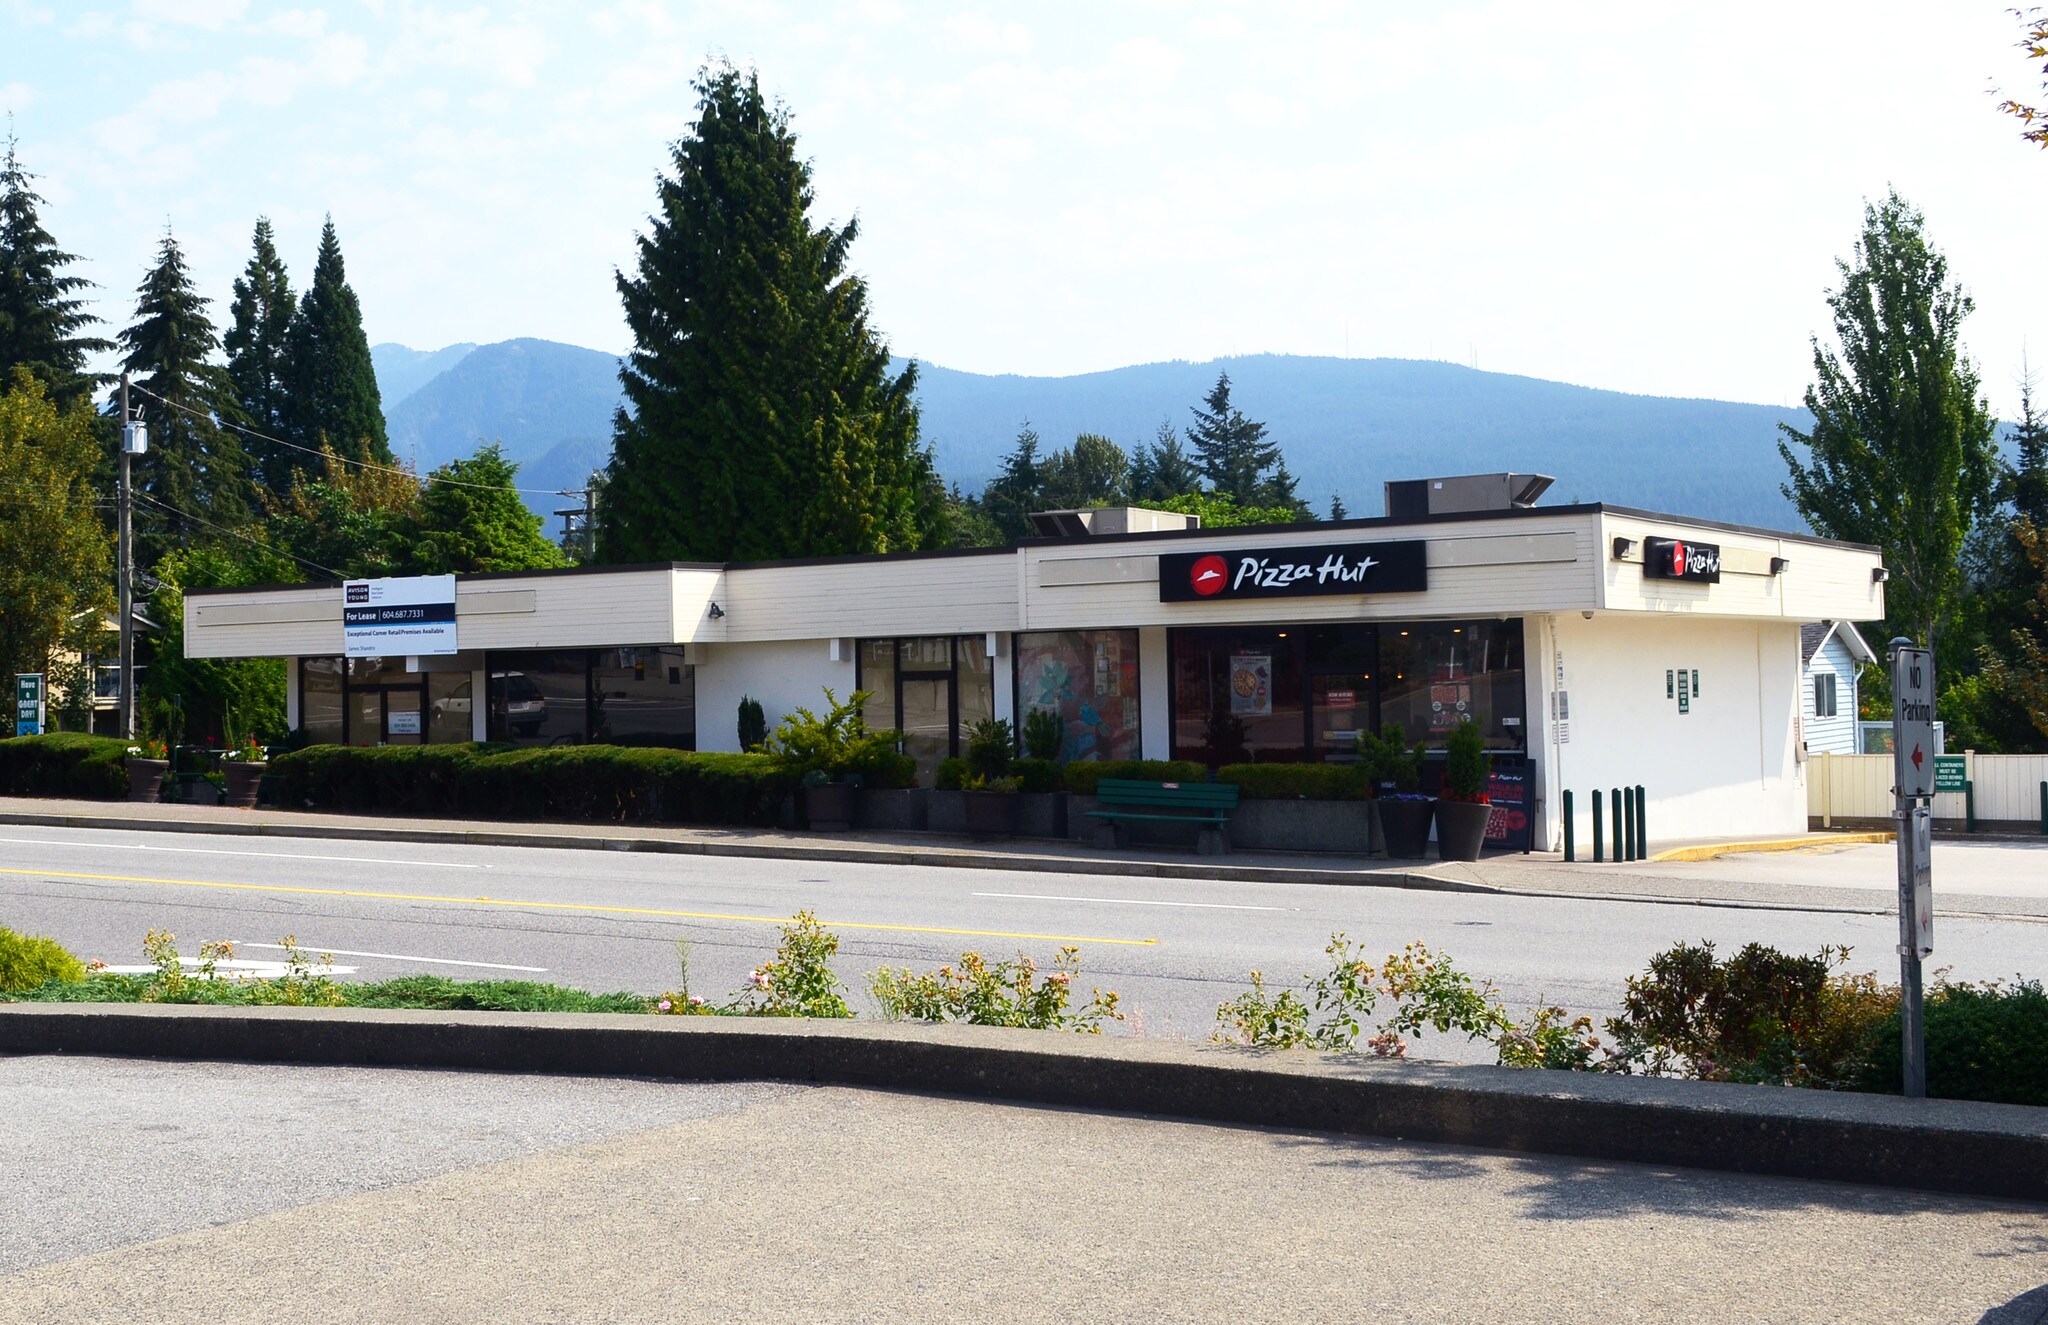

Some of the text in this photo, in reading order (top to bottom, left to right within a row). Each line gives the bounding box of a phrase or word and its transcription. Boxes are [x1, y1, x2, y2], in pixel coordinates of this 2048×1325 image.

[1682, 545, 1706, 573] Pizza
[1233, 554, 1380, 590] Pizza Hut
[346, 609, 424, 620] For Lease 604.687.7331
[20, 680, 35, 688] Have
[1909, 666, 1922, 690] NO
[18, 700, 37, 708] GREAT
[1901, 698, 1931, 727] Parking
[20, 710, 35, 718] DAY!
